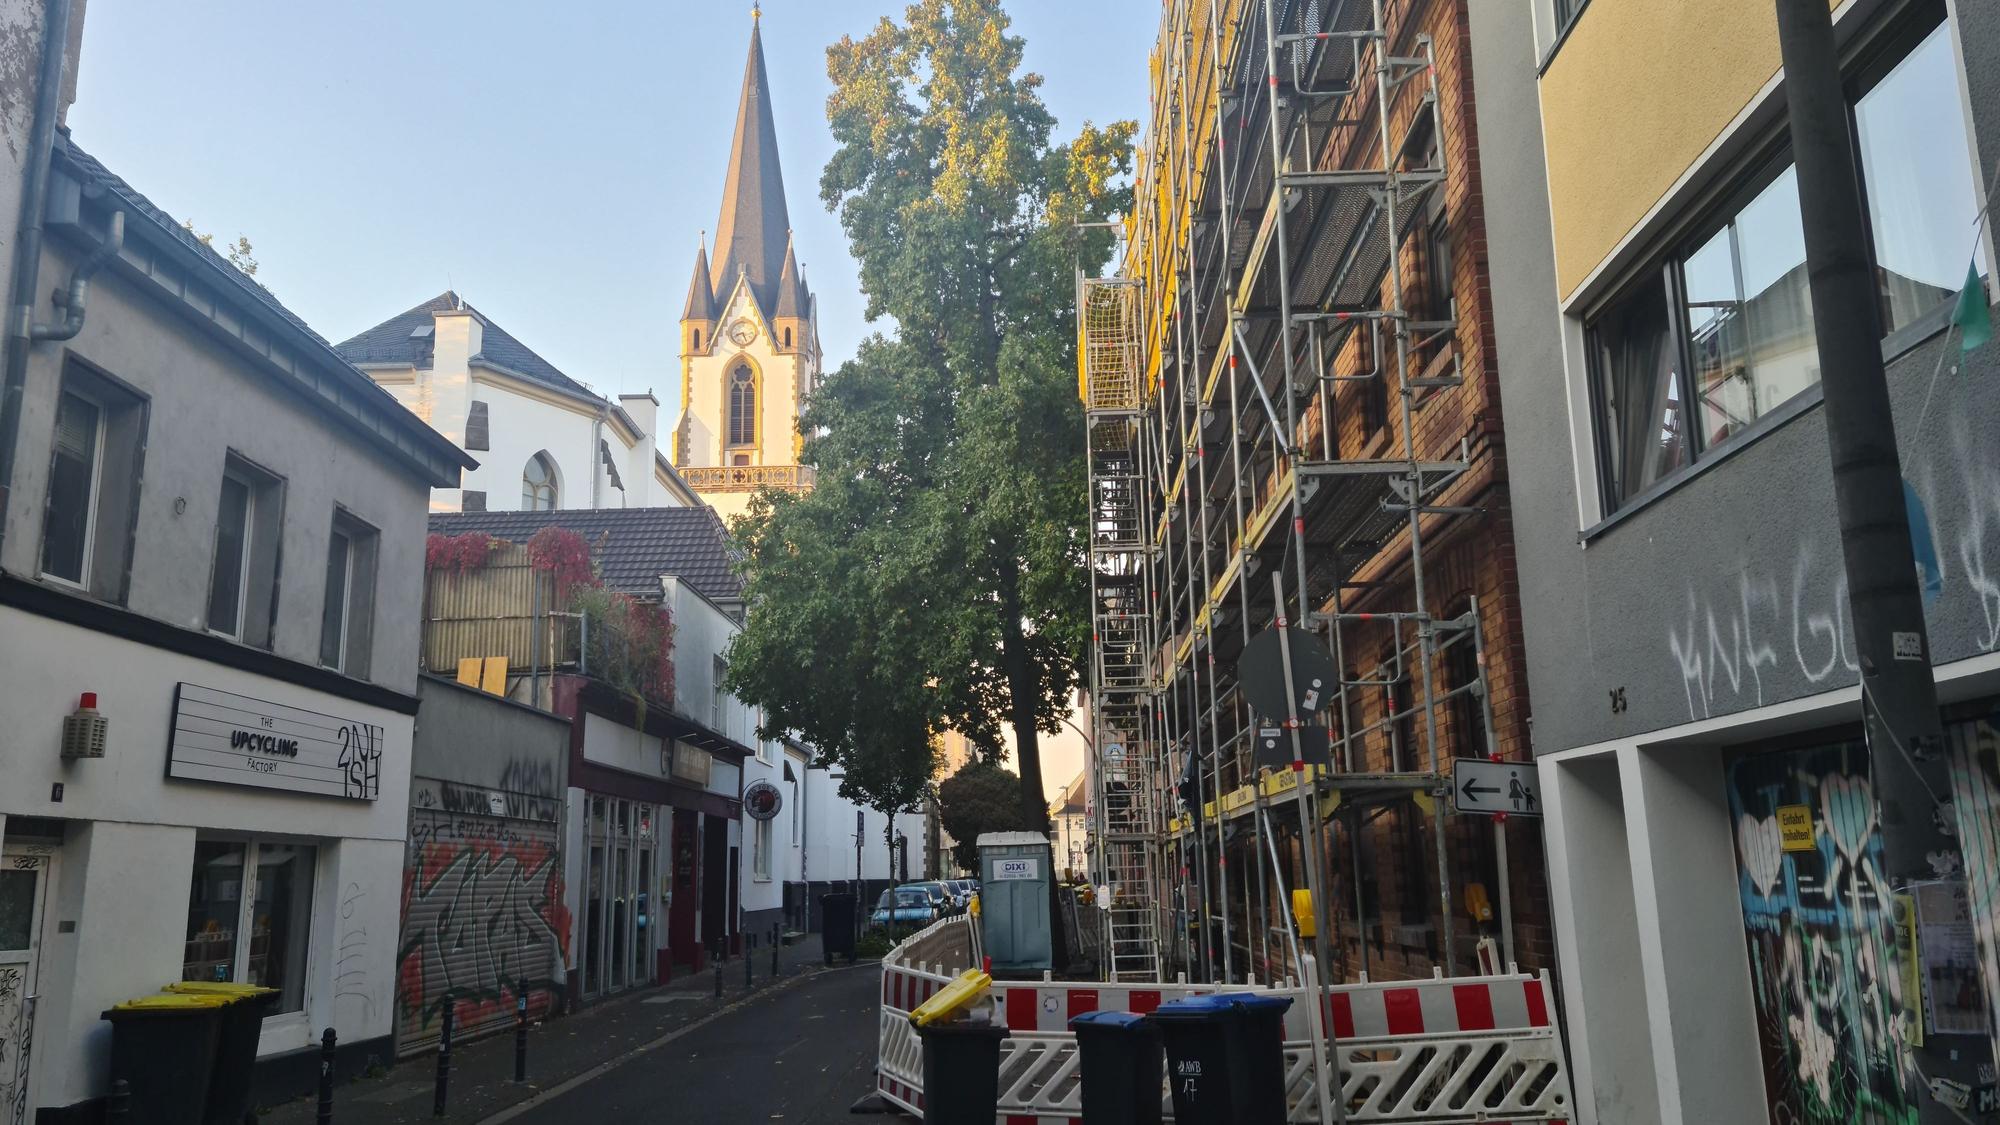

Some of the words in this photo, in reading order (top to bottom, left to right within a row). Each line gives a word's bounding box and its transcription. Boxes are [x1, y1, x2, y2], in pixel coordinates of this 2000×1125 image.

[260, 716, 274, 728] THE
[230, 728, 299, 759] UPCYCLING
[247, 757, 278, 774] FACTORY
[1004, 863, 1026, 871] DIXI
[1185, 1060, 1202, 1073] AWB
[1183, 1078, 1198, 1102] 17
